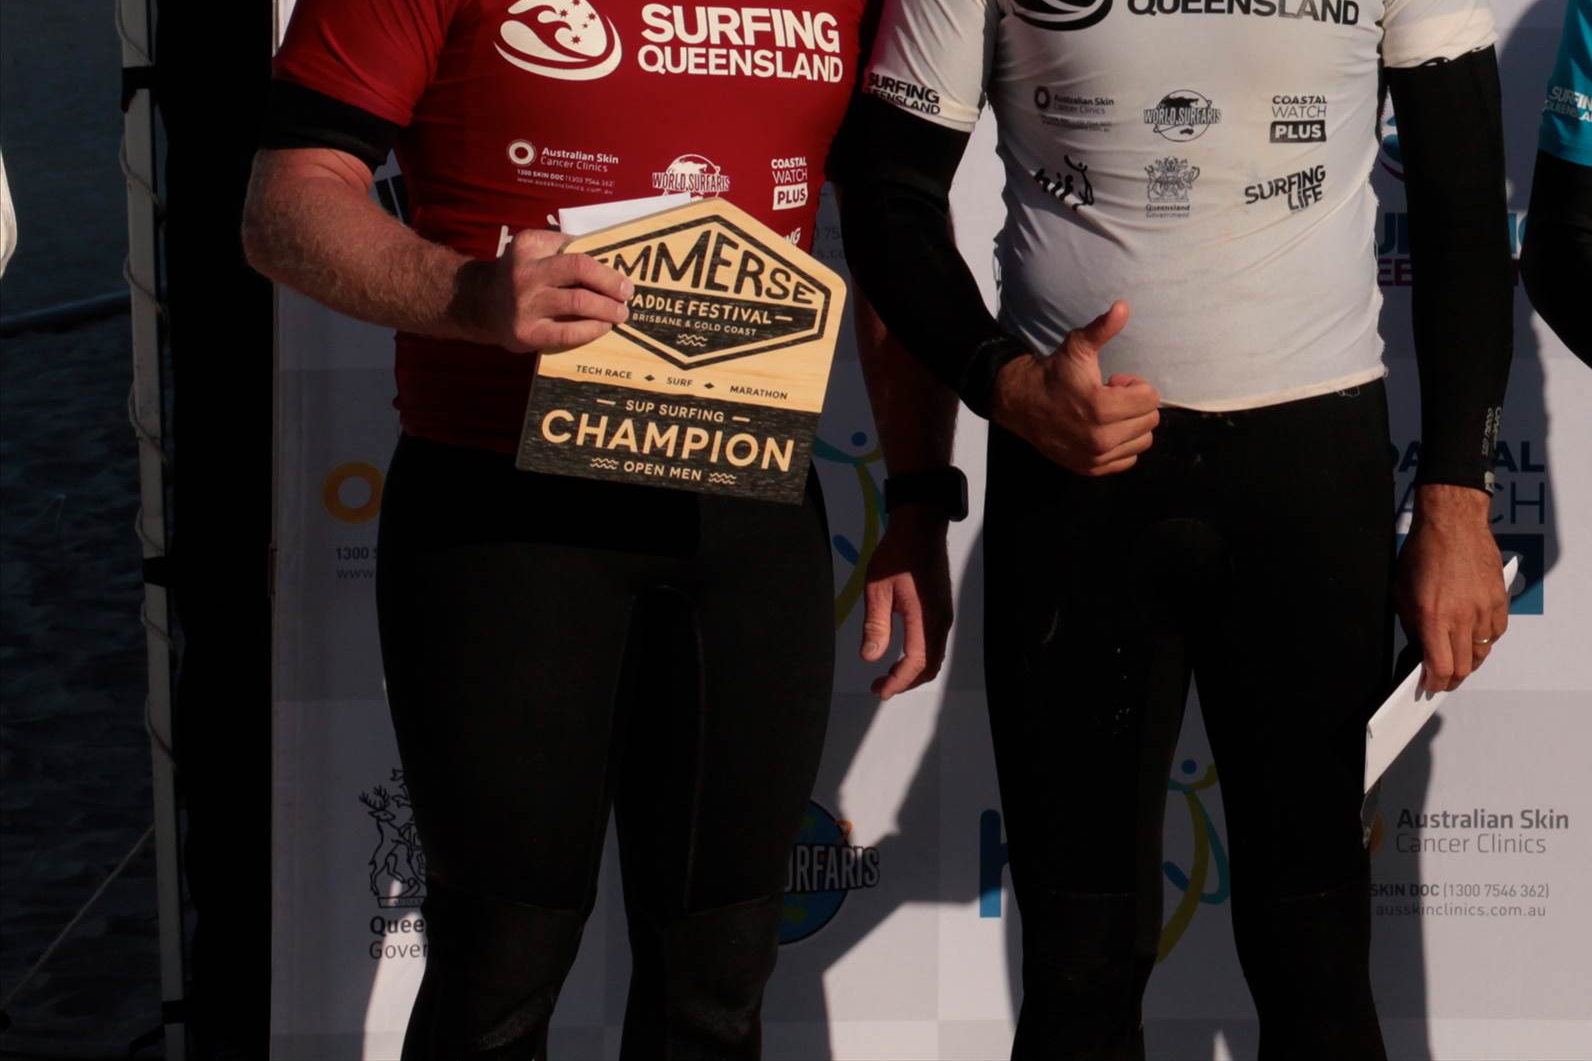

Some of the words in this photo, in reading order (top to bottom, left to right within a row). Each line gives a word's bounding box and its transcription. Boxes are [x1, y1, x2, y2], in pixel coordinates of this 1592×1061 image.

[641, 3, 840, 54] SURFING
[637, 45, 844, 83] QUEENSLAND
[1273, 95, 1327, 105] COASTAL
[1144, 108, 1176, 124] WORLD
[1178, 108, 1222, 125] SURFARIS
[1272, 106, 1326, 118] WATCH
[1275, 125, 1322, 138] PLUS
[541, 156, 574, 169] Cancer
[576, 160, 608, 173] Clinics
[542, 147, 595, 162] Australian
[597, 154, 619, 164] Skin
[771, 157, 807, 169] COASTAL
[652, 172, 686, 190] WORLD
[689, 173, 730, 192] SURFARIS
[772, 168, 808, 184] WATCH
[1245, 165, 1326, 204] SURFING
[777, 188, 806, 205] PLUS
[687, 300, 772, 325] FESTIVAL
[632, 313, 683, 326] BRISBANE
[694, 321, 721, 333] GOLD
[723, 325, 757, 336] COAST
[576, 364, 603, 376] TECH
[604, 368, 632, 380] RACE
[666, 376, 693, 388] SURF
[729, 385, 788, 400] MARATHON
[626, 399, 655, 414] SUP
[659, 404, 725, 423] SURFING
[541, 409, 794, 473] CHAMPION
[623, 460, 665, 477] OPEN
[669, 467, 703, 482] MEN
[336, 547, 369, 561] 1300
[1397, 808, 1513, 829] Australian
[1520, 809, 1569, 830] Skin
[1396, 833, 1470, 853] Cancer
[1477, 833, 1547, 854] Clinics
[1370, 884, 1405, 897] SKIN
[1409, 884, 1439, 897] DOC
[1443, 882, 1481, 899] (1300
[1485, 883, 1517, 897] 7546
